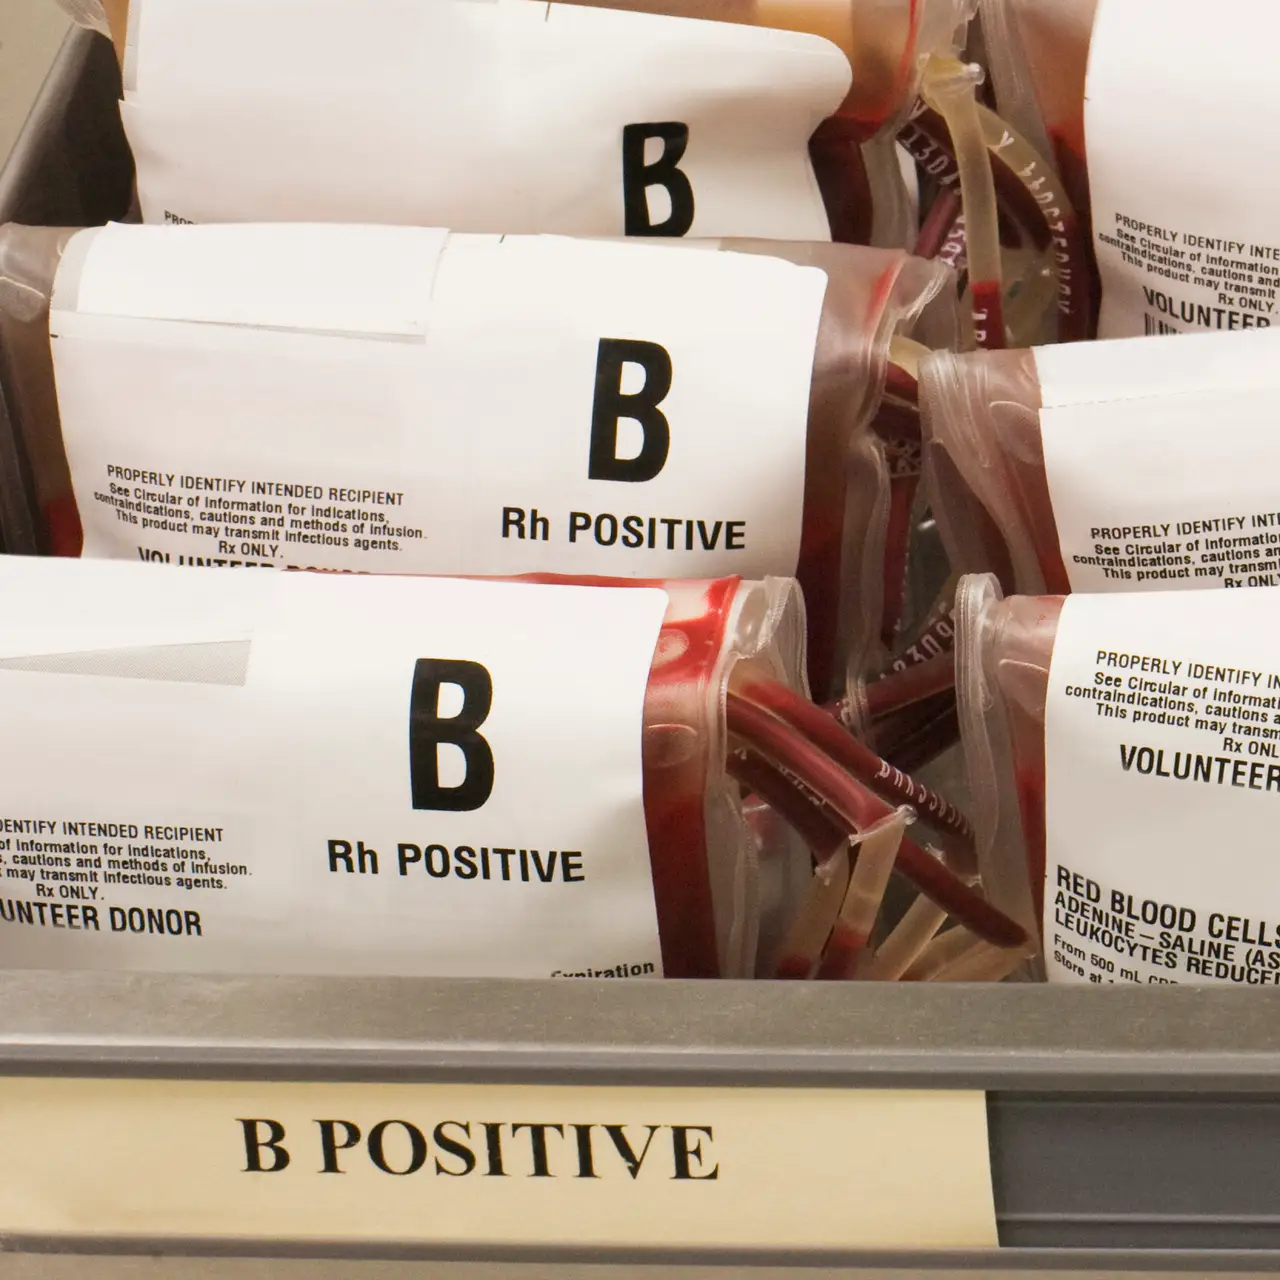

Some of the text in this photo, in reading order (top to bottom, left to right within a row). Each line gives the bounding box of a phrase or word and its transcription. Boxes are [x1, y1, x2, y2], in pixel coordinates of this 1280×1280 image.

[623, 122, 694, 237] B
[1116, 213, 1178, 242] PROPERLY
[1183, 234, 1245, 254] IDENTIFY
[588, 338, 672, 482] B
[107, 464, 403, 505] PROPERLY IDENTIFY INTENDED RECIPIENT
[502, 507, 746, 550] Rh POSITIVE
[1091, 524, 1170, 540] PROPERLY
[1177, 516, 1245, 535] IDENTIFY
[219, 540, 283, 558] Rx ONLY.
[1094, 672, 1122, 688] See
[1128, 676, 1188, 697] Circular
[1193, 687, 1208, 699] of
[1096, 651, 1182, 675] PROPERLY
[1188, 663, 1262, 687] IDENTIFY
[1065, 686, 1198, 715] contraindications,
[1205, 705, 1268, 723] cautions
[1096, 702, 1127, 719] This
[1133, 710, 1190, 728] product
[1195, 719, 1227, 733] may
[410, 659, 494, 811] B
[1223, 737, 1243, 753] Rx
[63, 821, 138, 839] INTENDED
[144, 825, 223, 842] RECIPIENT
[328, 840, 585, 882] Rh POSITIVE
[36, 883, 104, 900] Rx ONLY.
[1057, 864, 1101, 903] RED
[1110, 889, 1196, 933] BLOOD
[109, 907, 202, 936] DONOR
[1055, 908, 1178, 969] LEUKOCYTES
[236, 1119, 718, 1180] B POSITIVE
